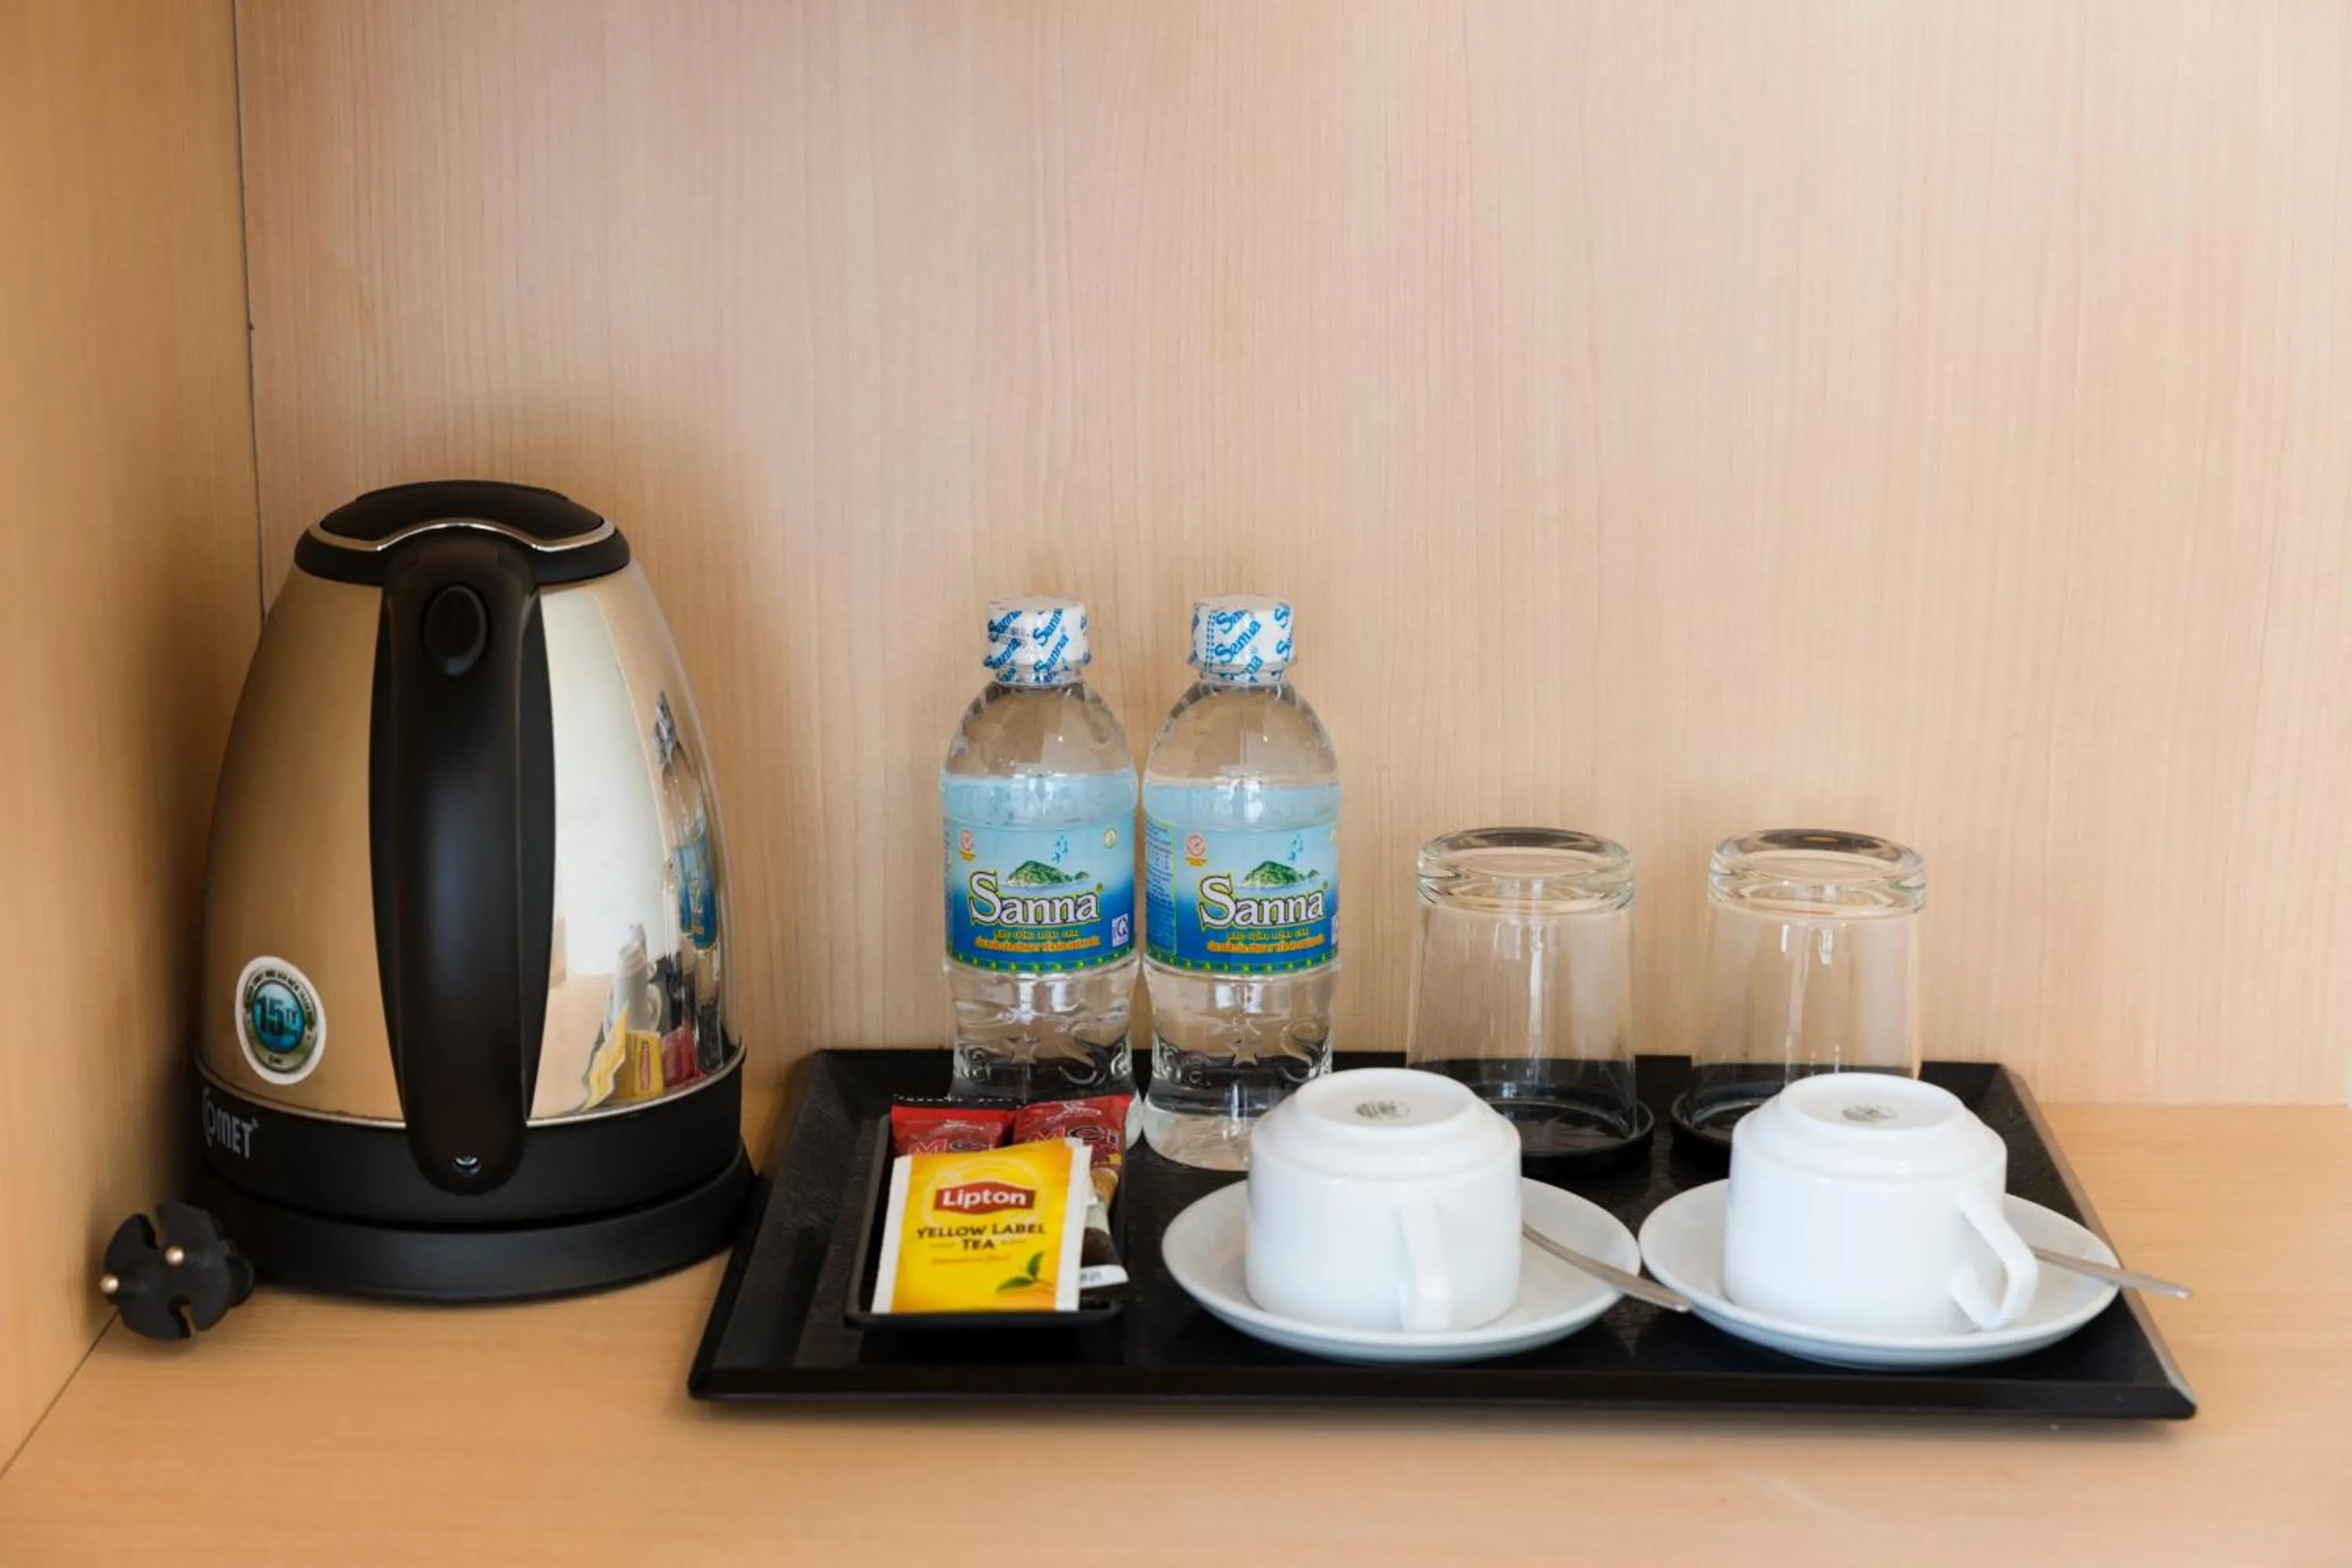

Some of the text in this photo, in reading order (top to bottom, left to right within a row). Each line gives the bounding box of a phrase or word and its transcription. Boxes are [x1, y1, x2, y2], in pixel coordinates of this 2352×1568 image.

[1214, 620, 1261, 663] Sanna
[969, 870, 1100, 926] Sanna
[1200, 873, 1325, 928] Sanna
[942, 1189, 1027, 1210] Lipton
[916, 1222, 1047, 1240] YELLOW LABEL
[962, 1238, 996, 1251] TEA
